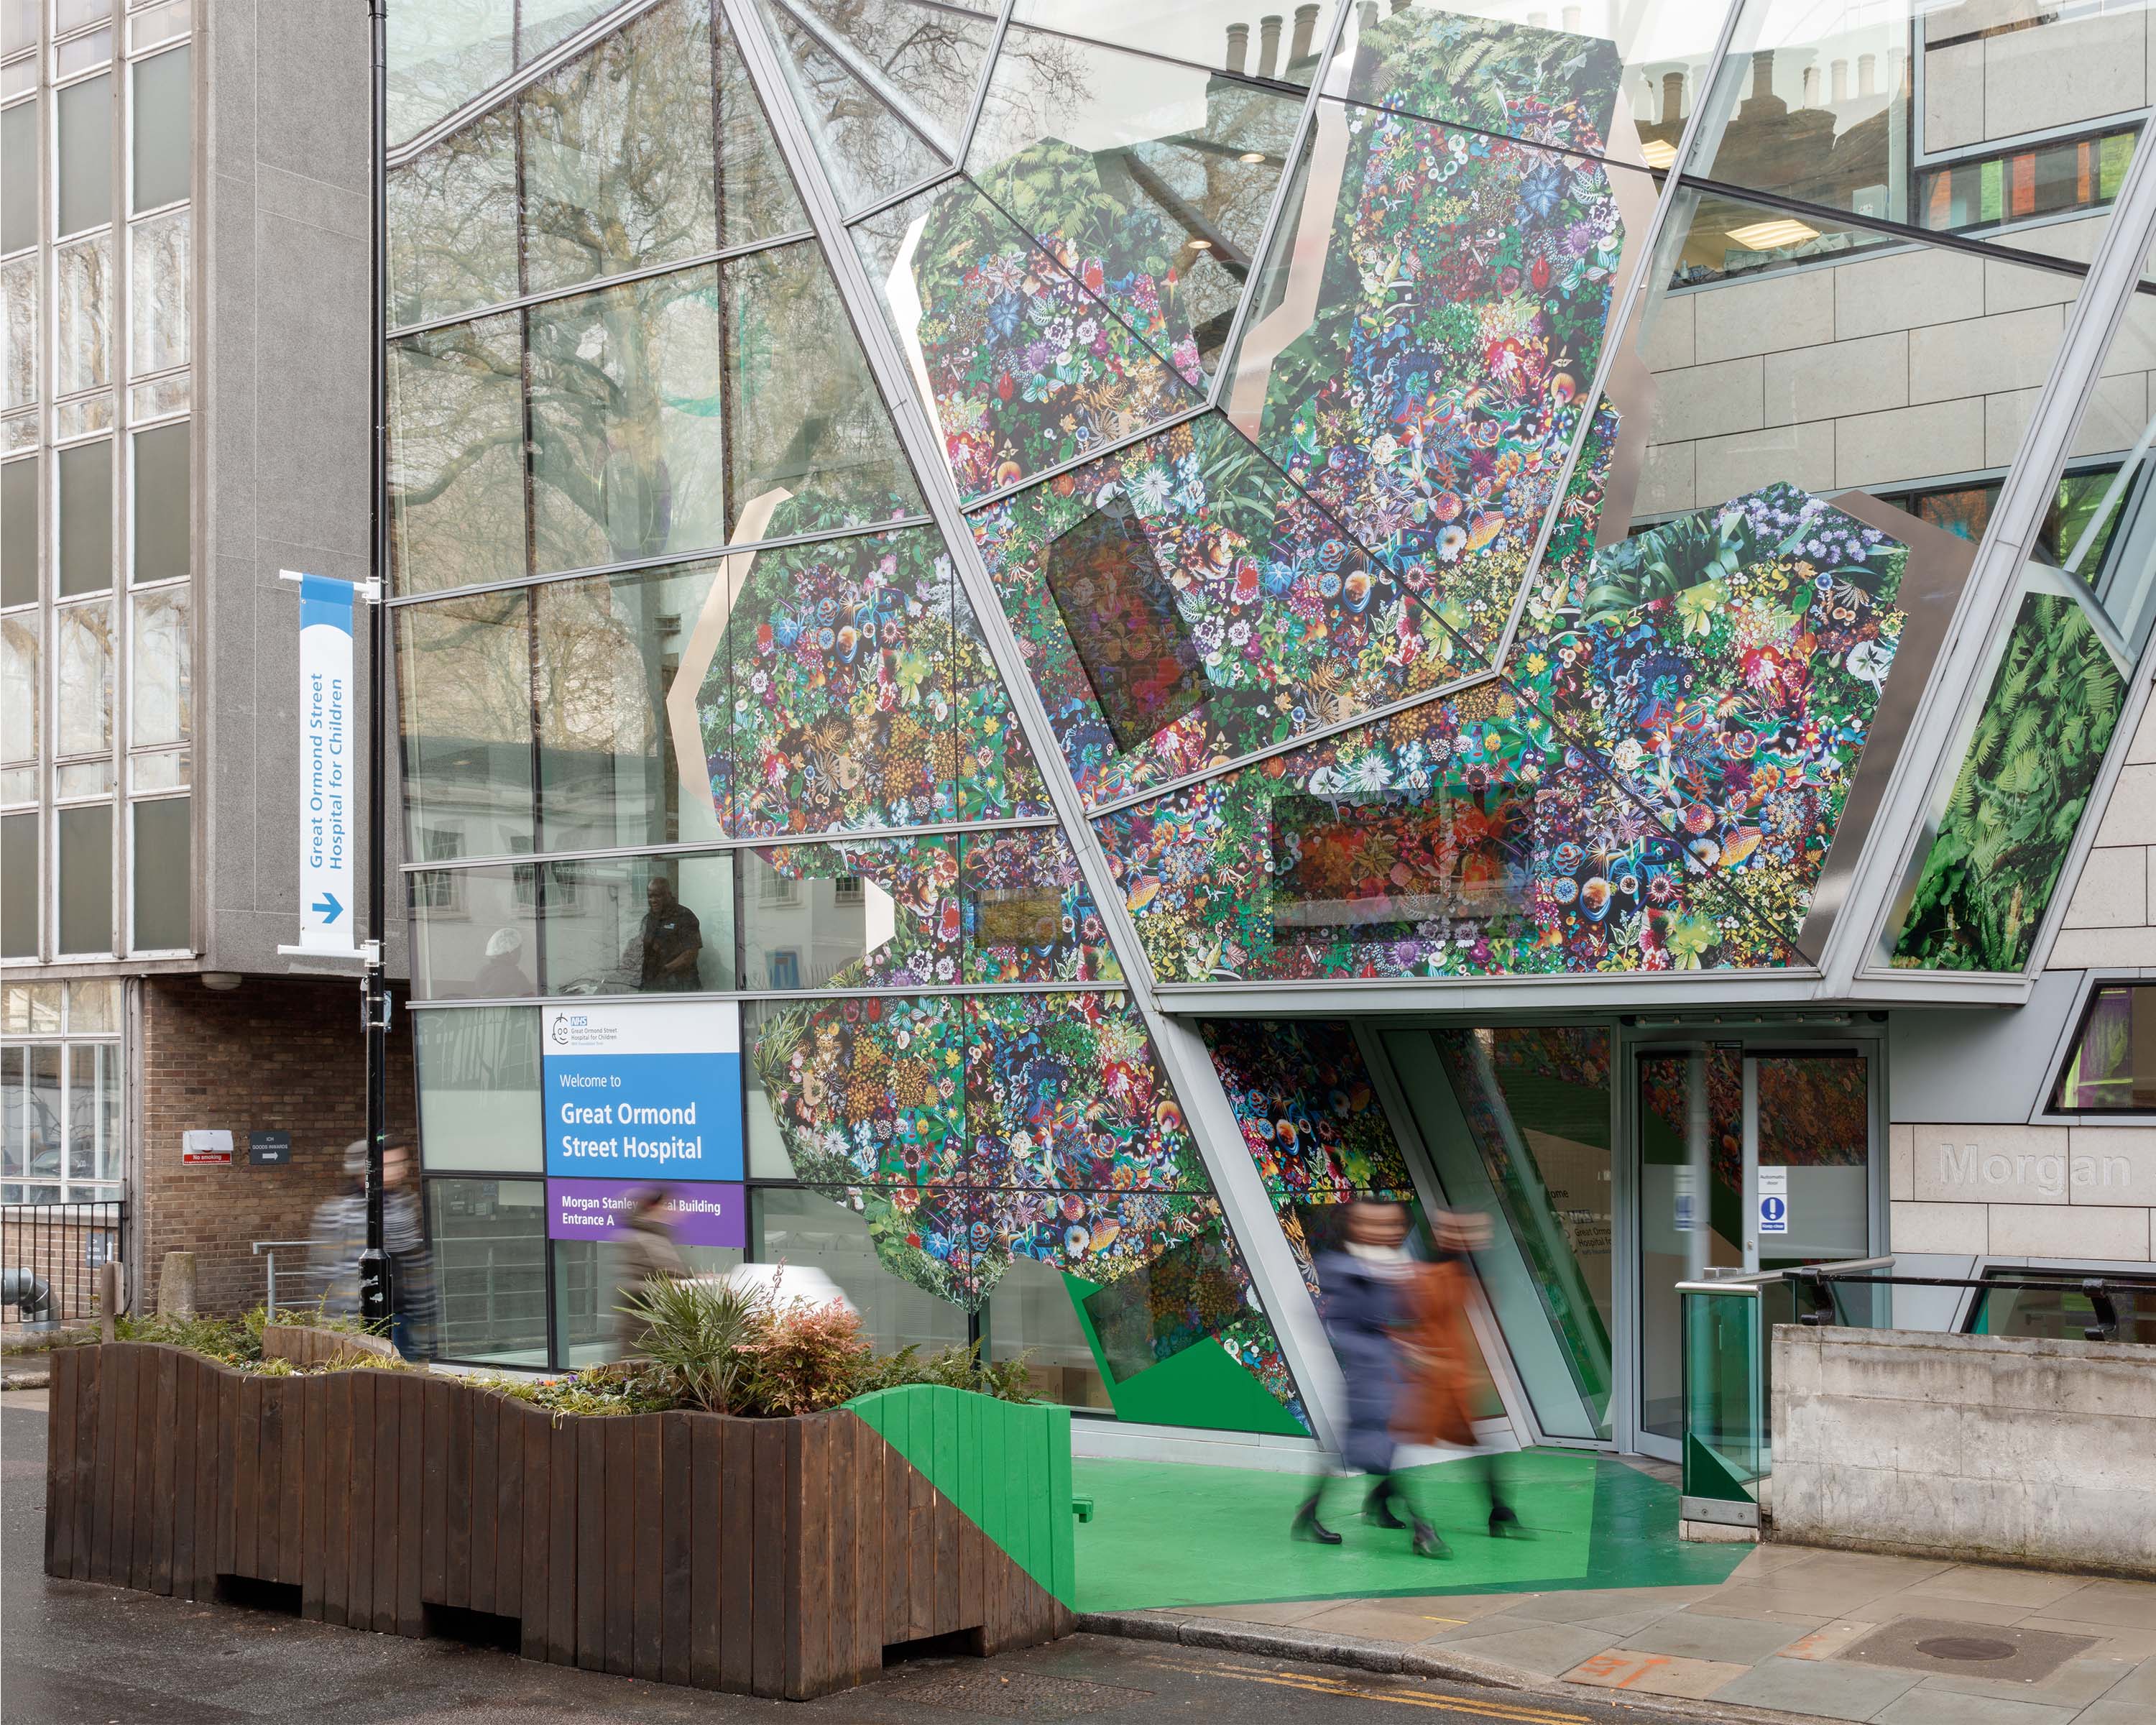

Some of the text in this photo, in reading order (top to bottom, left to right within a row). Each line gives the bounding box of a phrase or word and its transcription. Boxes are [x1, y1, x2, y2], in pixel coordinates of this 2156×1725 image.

[309, 673, 323, 868] Great Ormond Street
[329, 678, 346, 870] Hospital for Children
[571, 1016, 587, 1026] NHS
[559, 1074, 622, 1087] Welcome to
[561, 1102, 696, 1125] Great Ormond
[562, 1136, 702, 1164] Street Hospital
[1940, 1144, 2132, 1197] Morgan
[562, 1196, 599, 1210] Morgan
[602, 1197, 638, 1213] Stanley
[679, 1200, 721, 1216] Building
[562, 1213, 614, 1225] Entrance A
[1575, 1227, 1611, 1236] Great Ormo
[1578, 1237, 1605, 1247] Hospital
